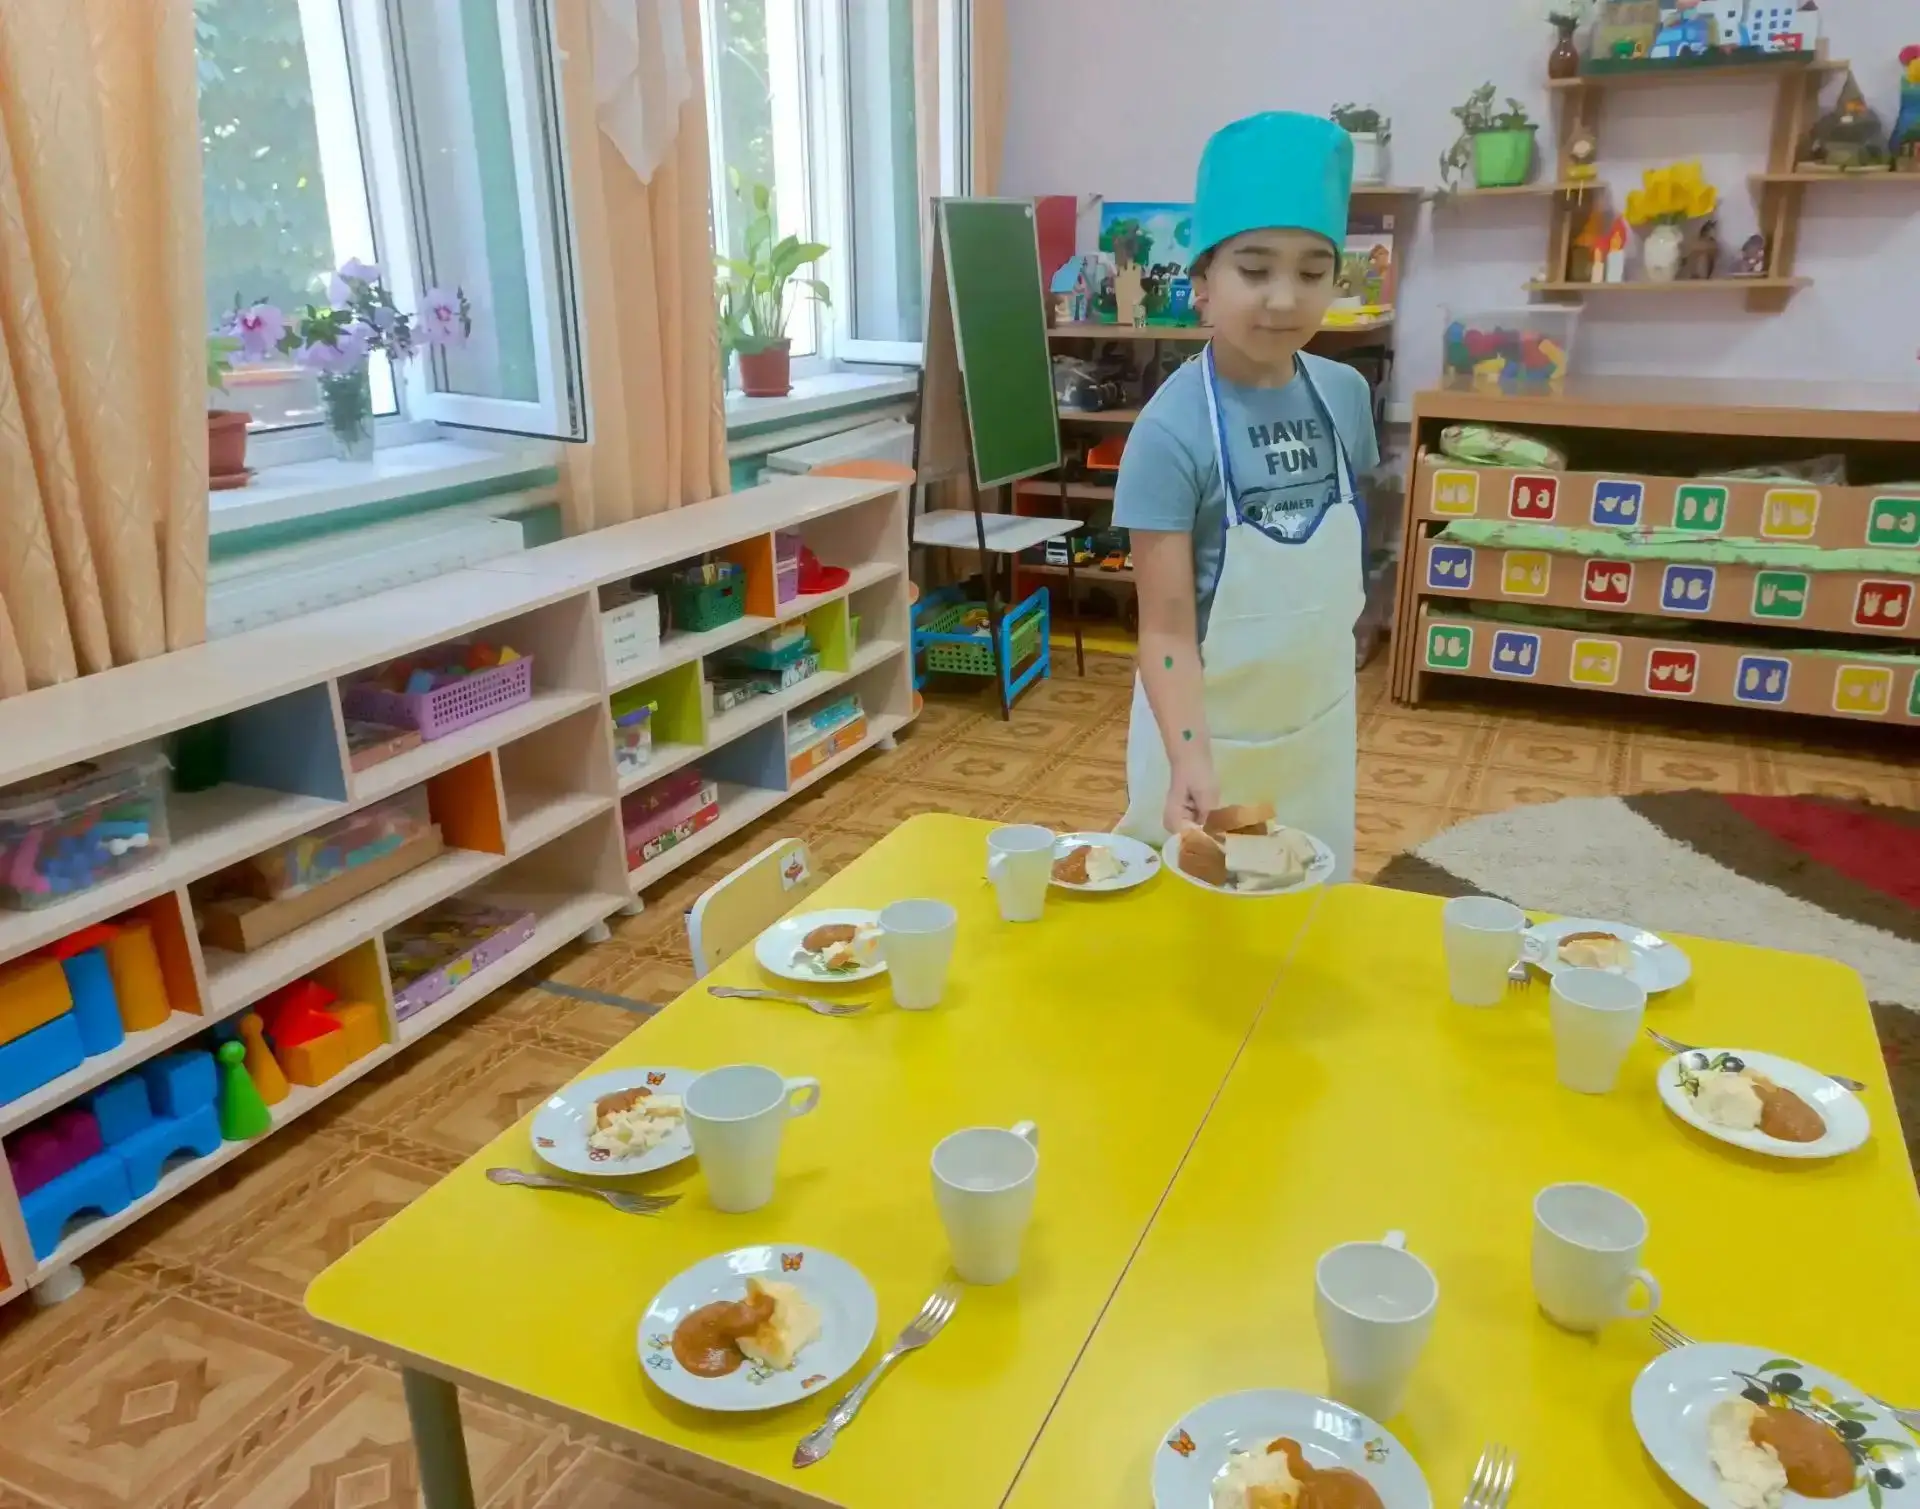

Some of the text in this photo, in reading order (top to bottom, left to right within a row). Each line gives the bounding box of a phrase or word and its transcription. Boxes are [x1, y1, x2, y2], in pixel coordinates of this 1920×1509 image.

[1247, 418, 1322, 448] HAVE
[1265, 447, 1318, 475] FUN
[1274, 498, 1315, 512] GAMER
